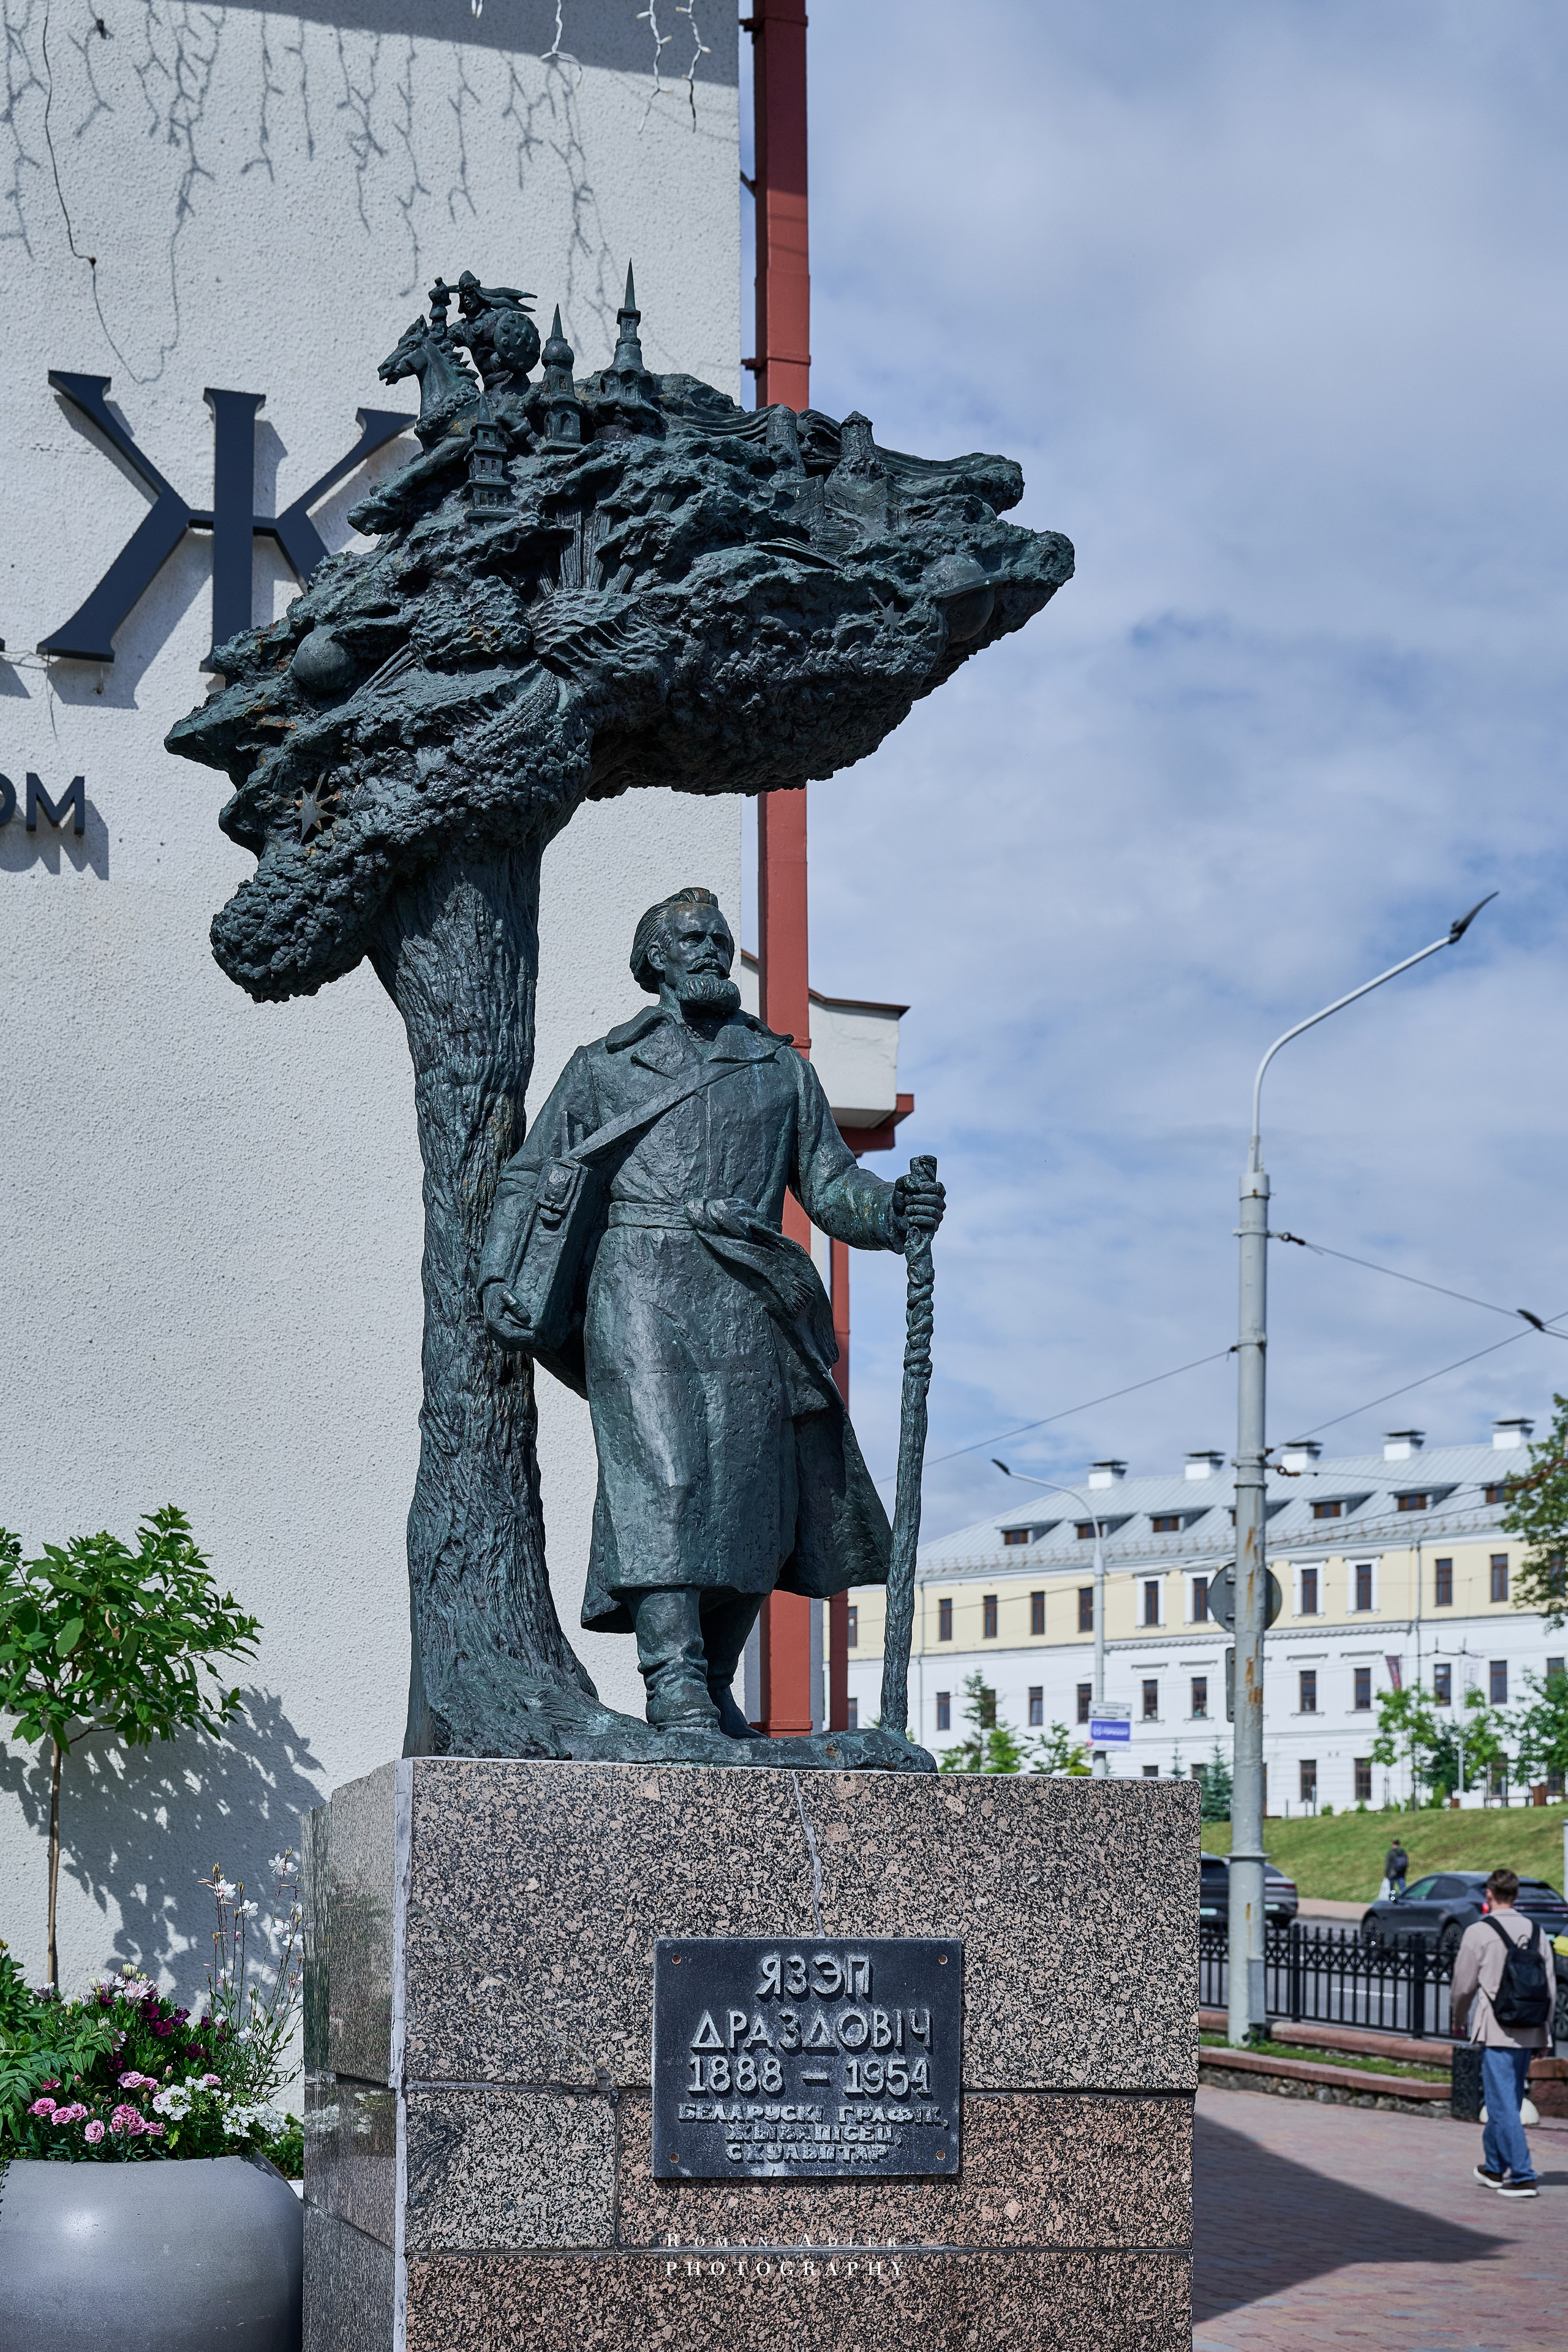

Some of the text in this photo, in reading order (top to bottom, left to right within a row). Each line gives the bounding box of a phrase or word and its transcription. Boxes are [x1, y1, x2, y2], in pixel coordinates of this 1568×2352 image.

[0, 370, 418, 673] Ж
[756, 1954, 871, 1999] ЯЗЭП
[690, 2009, 932, 2051] ДРАЗДОВІЧ
[688, 2056, 785, 2095] 1888
[844, 2058, 932, 2098] 1954
[677, 2103, 949, 2130] БЕЛАРУСКІ ГРАФІК,
[725, 2143, 888, 2163] СКУЛЬПТАР
